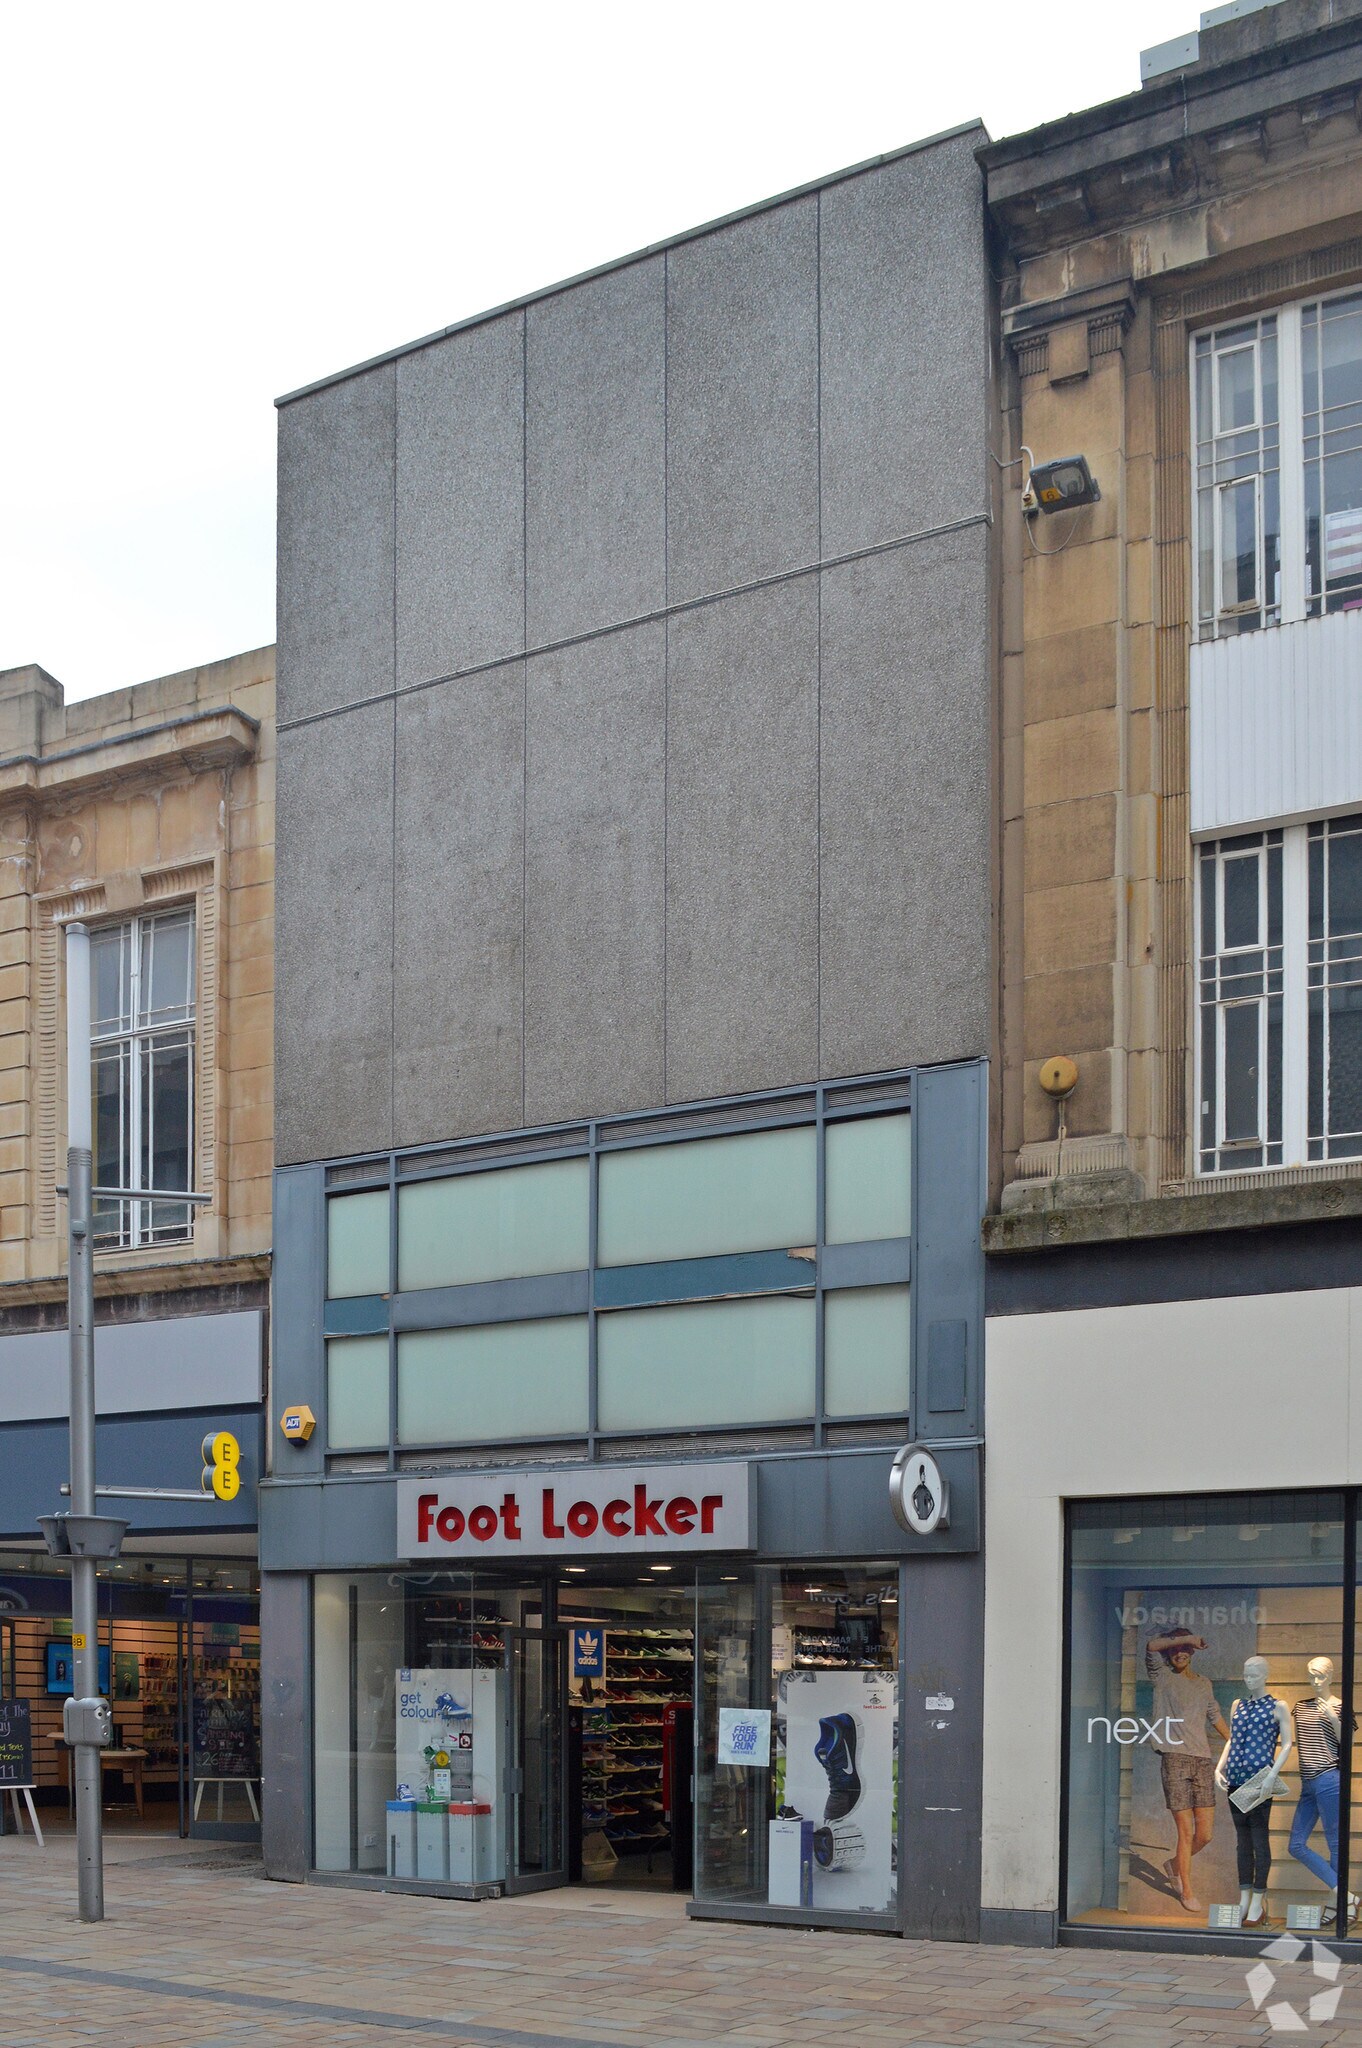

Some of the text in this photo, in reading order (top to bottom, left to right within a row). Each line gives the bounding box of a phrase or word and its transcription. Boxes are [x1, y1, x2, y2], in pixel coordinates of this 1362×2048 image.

[1046, 490, 1055, 500] 6
[286, 1418, 300, 1428] ADT
[417, 1484, 723, 1543] Foot Locker
[578, 1656, 598, 1665] adidas
[401, 1692, 421, 1706] get
[401, 1706, 438, 1718] colour
[734, 1725, 757, 1734] FREE
[1087, 1716, 1184, 1745] next
[732, 1733, 757, 1742] YOUR
[734, 1742, 754, 1750] RUN
